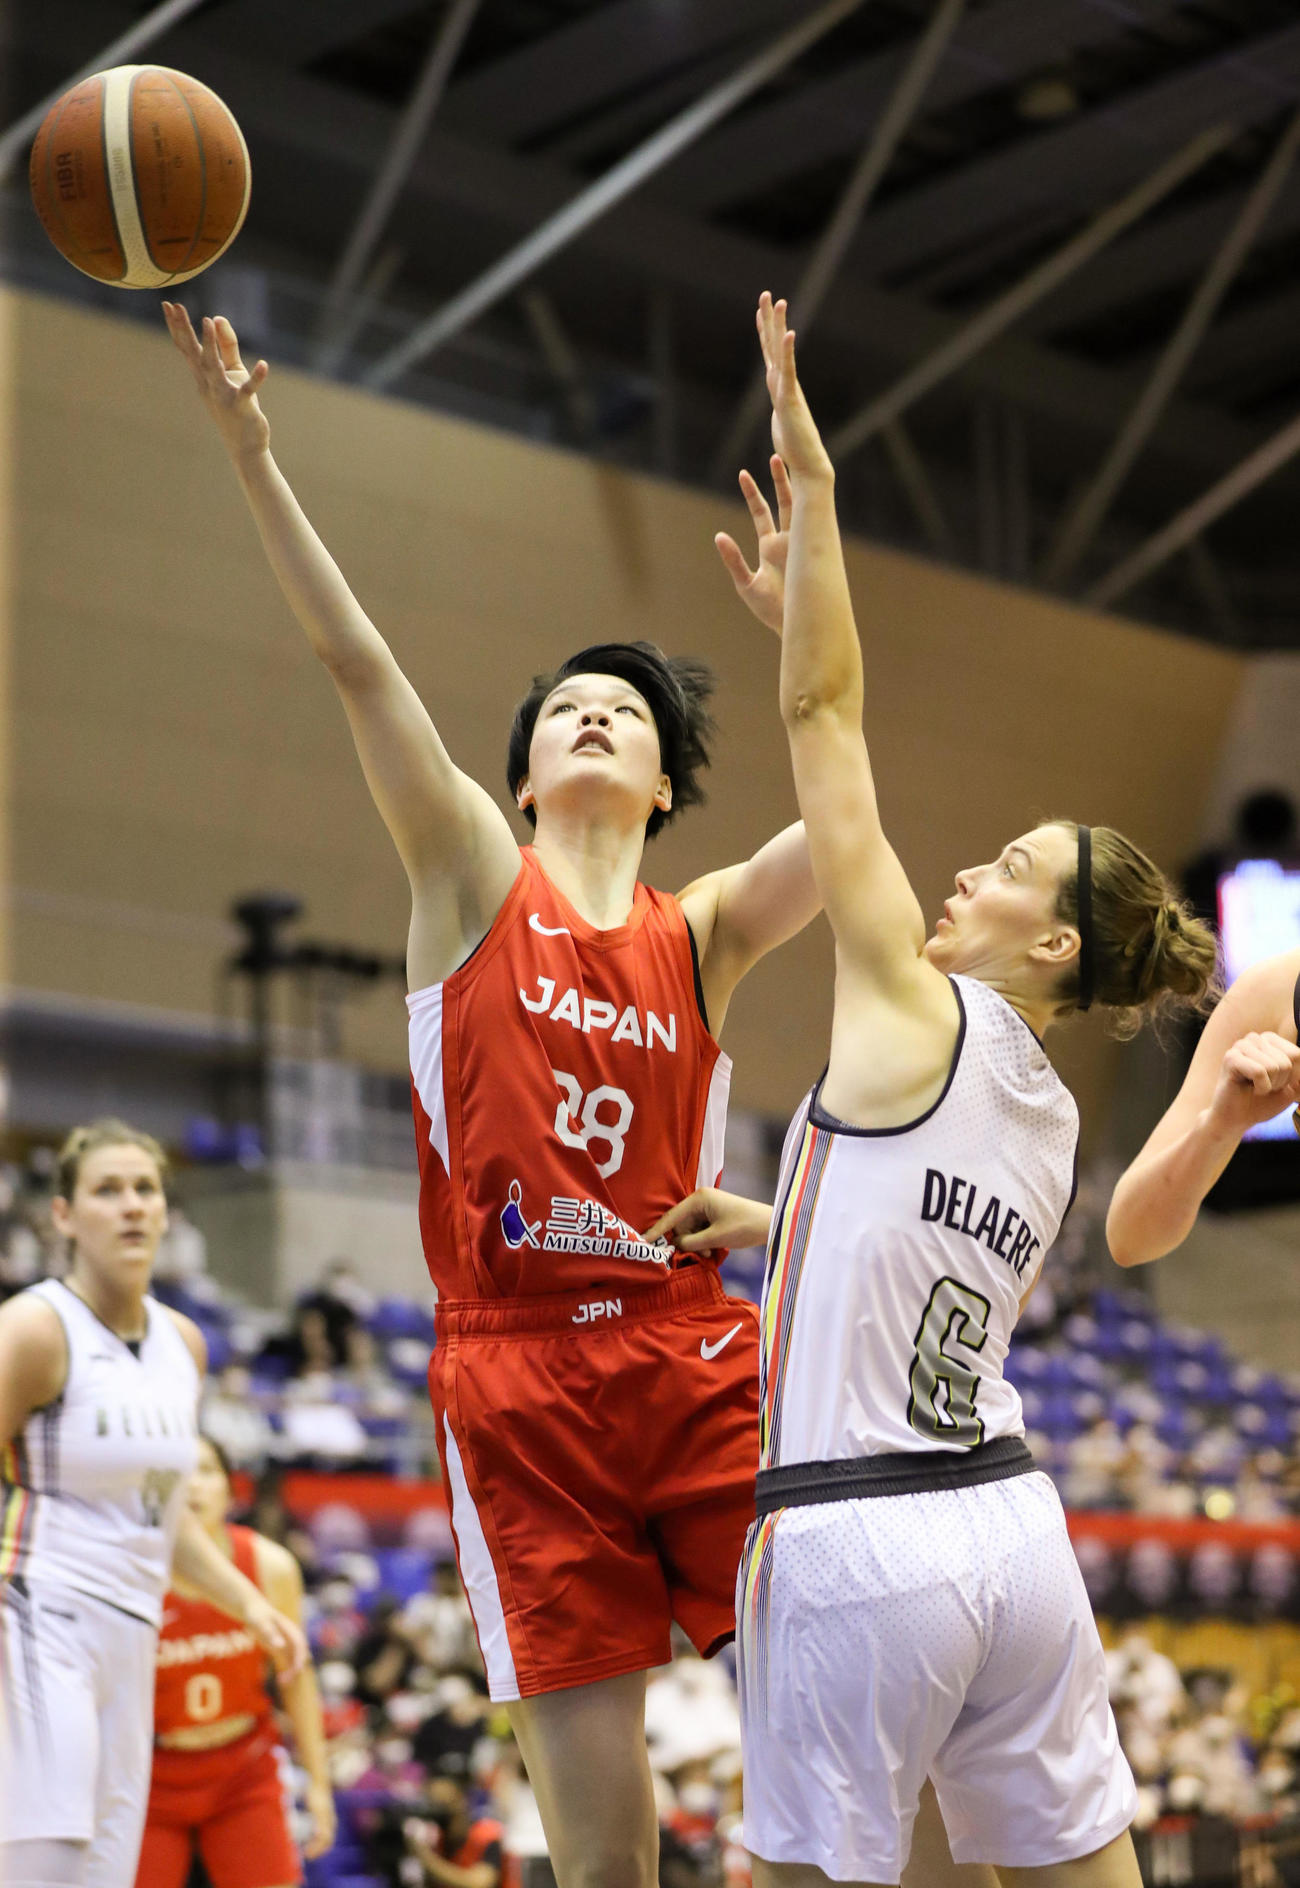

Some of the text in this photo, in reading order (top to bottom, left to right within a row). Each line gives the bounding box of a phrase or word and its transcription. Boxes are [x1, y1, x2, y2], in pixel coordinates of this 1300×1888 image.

[57, 151, 76, 201] FIBA
[519, 975, 677, 1053] JAPAN
[543, 1231, 613, 1256] MITSUI
[572, 1298, 623, 1324] JPN
[906, 1275, 991, 1448] 6
[185, 1673, 222, 1721] 0
